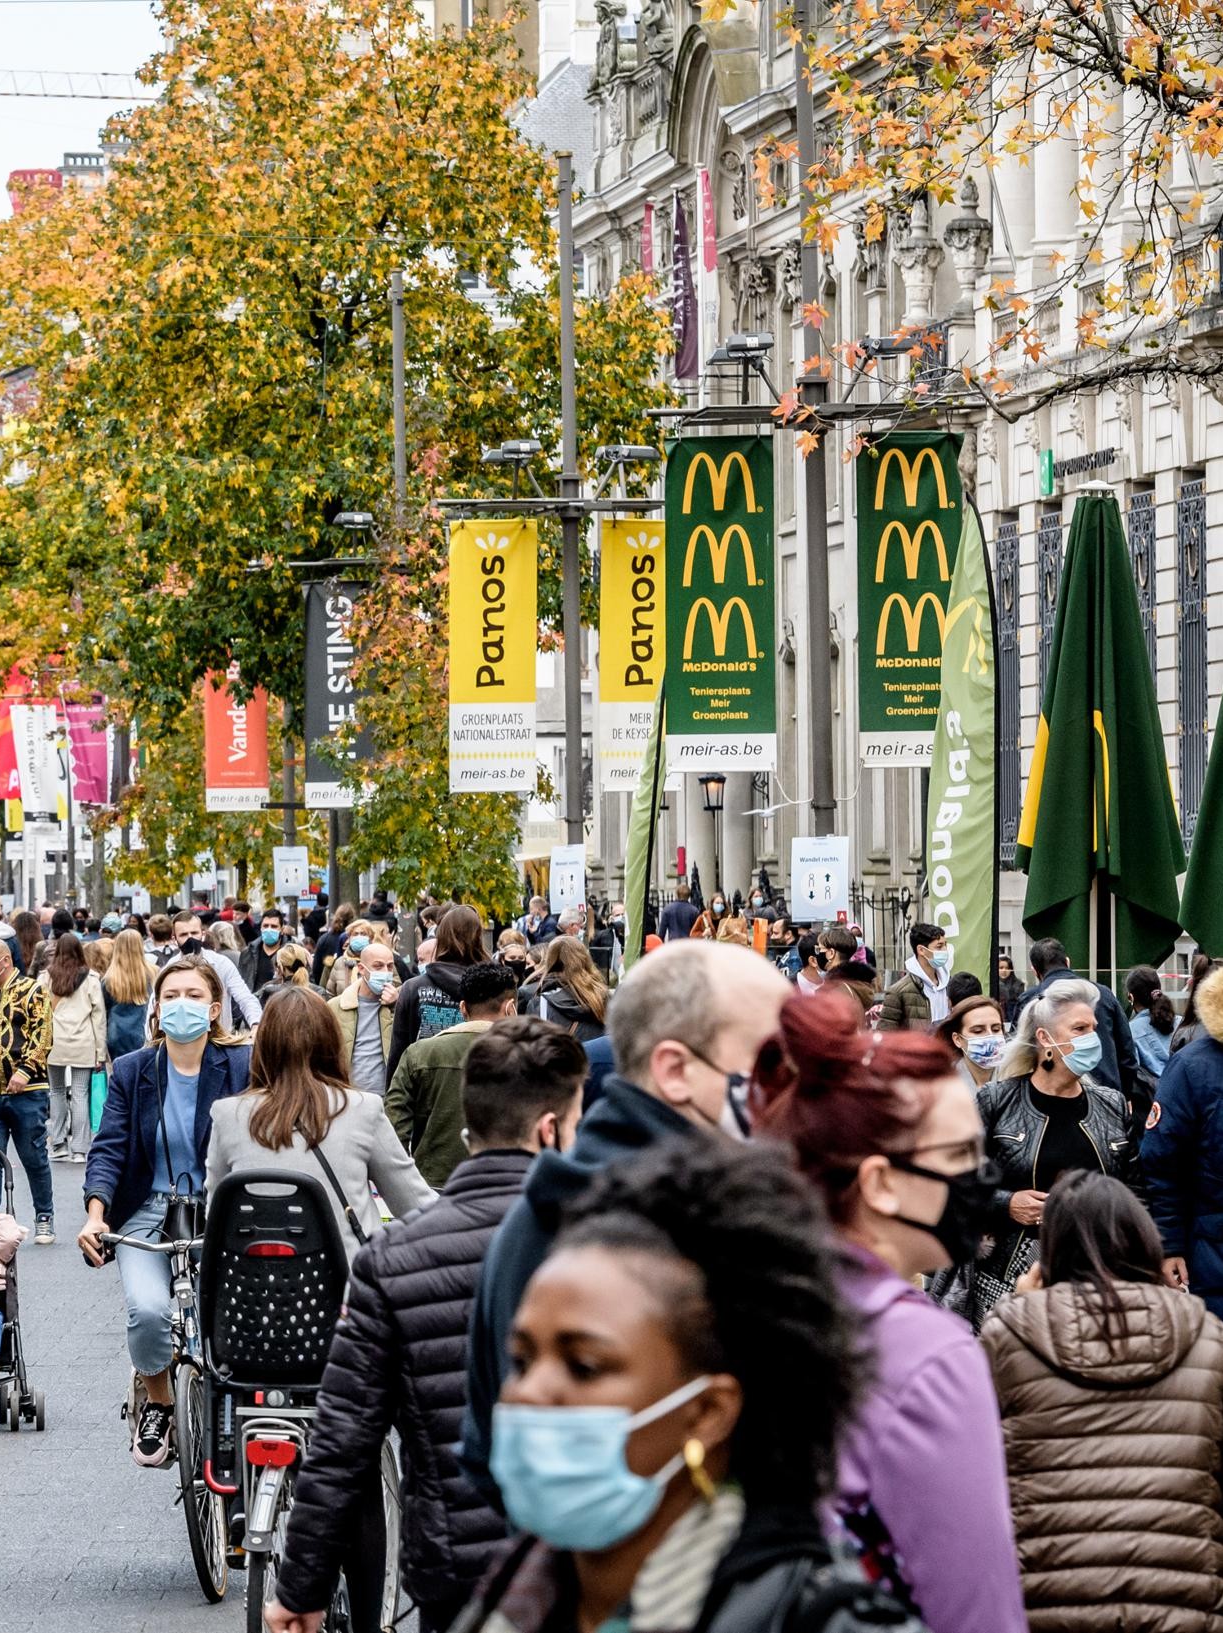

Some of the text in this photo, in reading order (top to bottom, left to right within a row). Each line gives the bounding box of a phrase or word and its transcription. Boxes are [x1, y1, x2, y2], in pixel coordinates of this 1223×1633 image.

[476, 553, 505, 688] Panos
[625, 553, 656, 687] Panos
[326, 595, 354, 694] STING
[682, 661, 757, 673] McDonald's
[875, 657, 942, 668] McDonald
[689, 687, 751, 697] Teniersplaats
[904, 694, 924, 703] Meir
[710, 699, 730, 708] Meir
[461, 712, 524, 726] GROENPLAATS
[629, 712, 652, 724] MEIR
[692, 711, 749, 721] Groenplaats
[453, 728, 531, 741] NATIONALESTRAAT
[612, 727, 651, 740] DE KEYSE
[680, 741, 763, 756] meir-as.be
[866, 741, 934, 756] meir-as
[460, 766, 526, 780] meir-as.be
[610, 767, 639, 778] meir-
